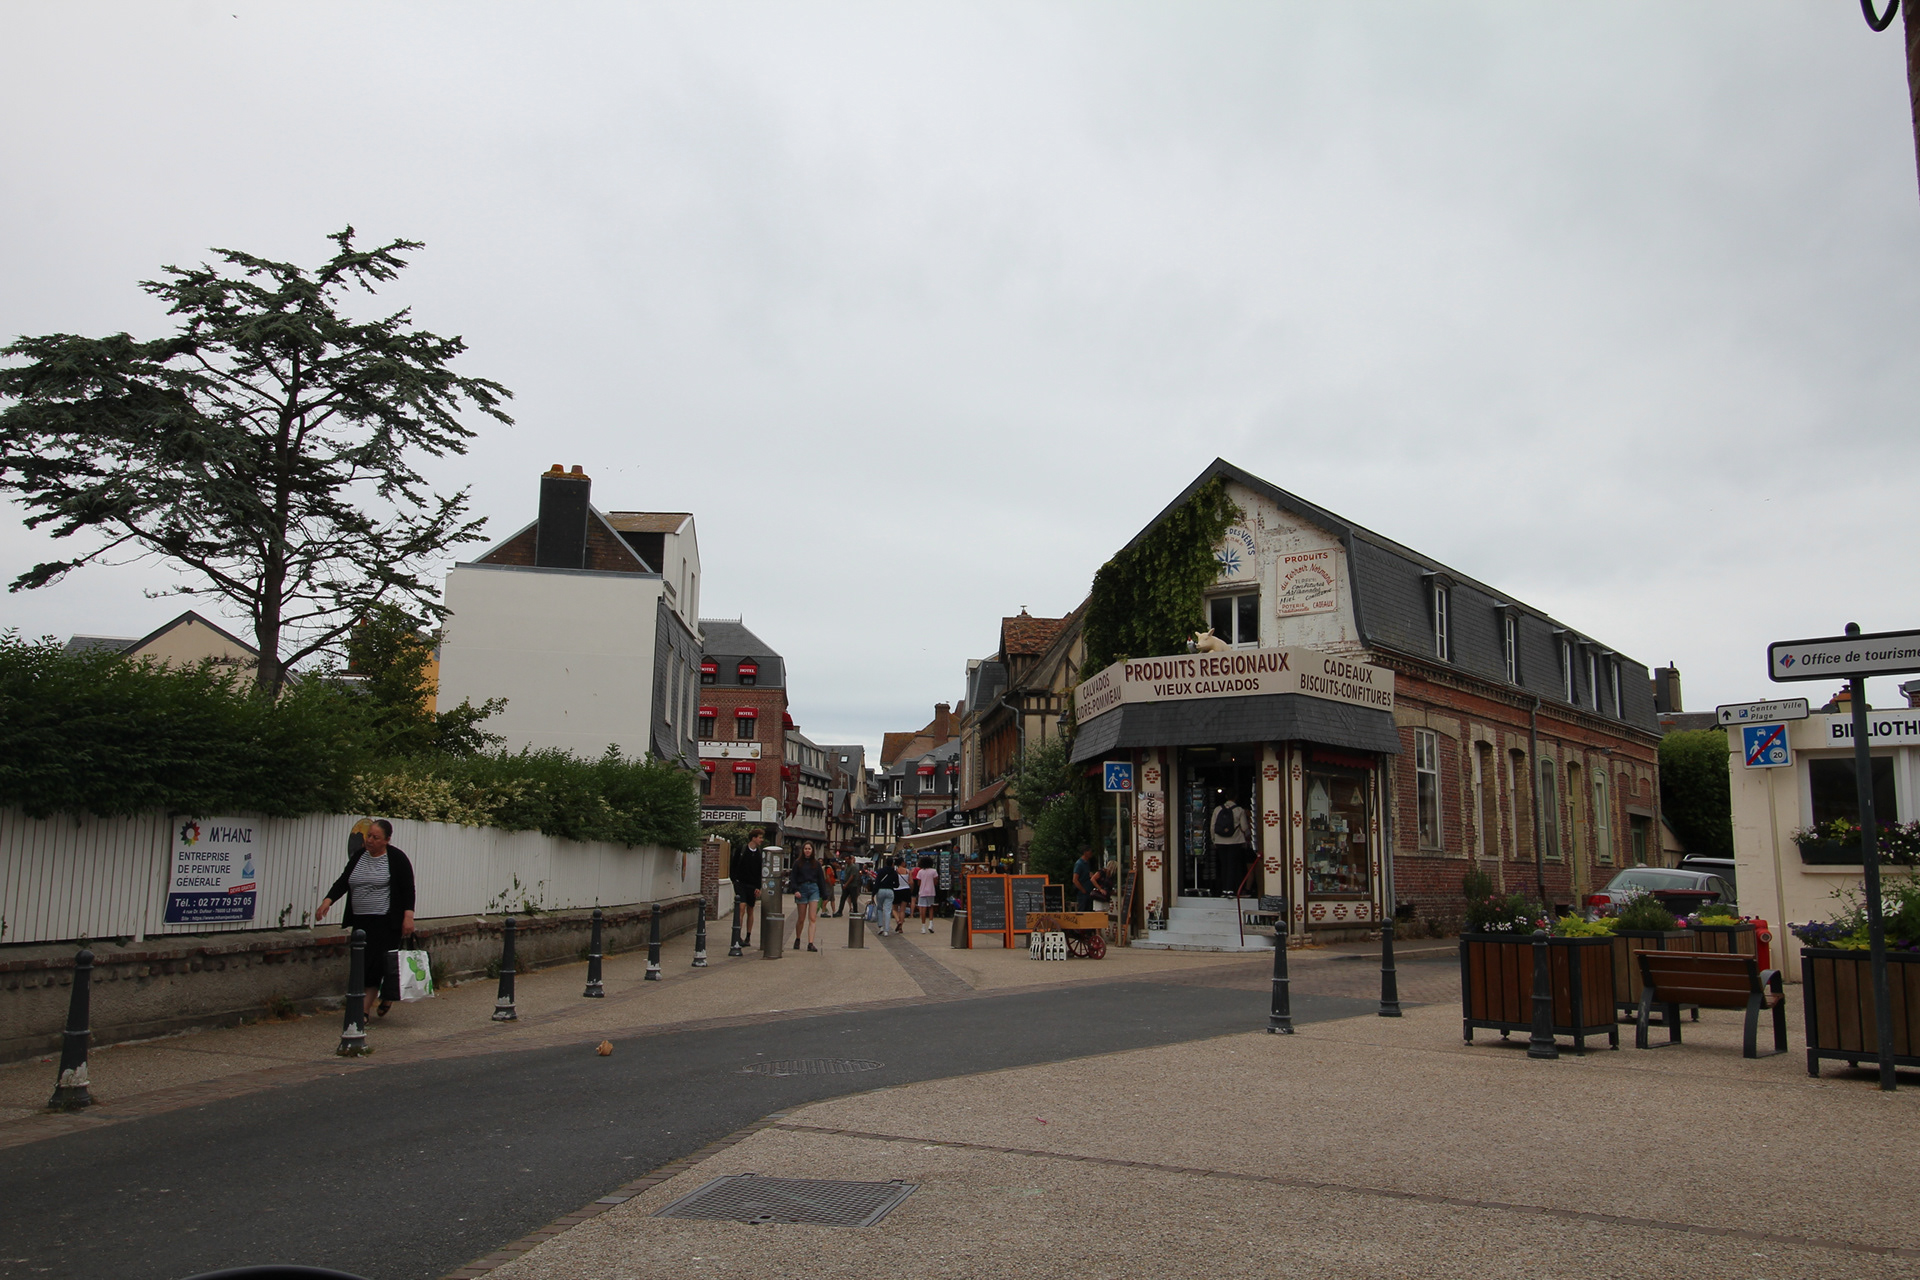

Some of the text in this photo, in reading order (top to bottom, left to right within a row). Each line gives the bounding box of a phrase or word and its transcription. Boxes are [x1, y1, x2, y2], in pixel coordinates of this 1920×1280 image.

[1241, 530, 1256, 556] VENTS
[1284, 552, 1329, 564] PRODUITS
[1125, 652, 1291, 682] PRODUITS REGIONAUX
[1801, 653, 1841, 666] Office
[1845, 651, 1861, 662] de
[1323, 659, 1373, 684] CADEAUX
[1082, 672, 1110, 700] CALVADOS
[1154, 678, 1260, 696] VIEUX CALVADOS
[1300, 673, 1392, 706] BISCUITS-CONFITURES
[1076, 685, 1122, 720] CIDRE-POMMEAU
[1750, 713, 1774, 721] Plage
[1832, 720, 1920, 738] BIIOTH
[1147, 792, 1155, 849] BISCUITERIE
[209, 827, 252, 843] M'HANI
[178, 852, 230, 861] ENTREPRISE
[177, 864, 231, 874] DE PEINTURE
[176, 875, 221, 887] GÉNÉRALE
[175, 898, 190, 907] Tél.
[198, 898, 208, 907] 02
[210, 898, 221, 906] 77
[222, 897, 231, 906] 79
[233, 897, 242, 906] 57
[242, 897, 252, 906] 05
